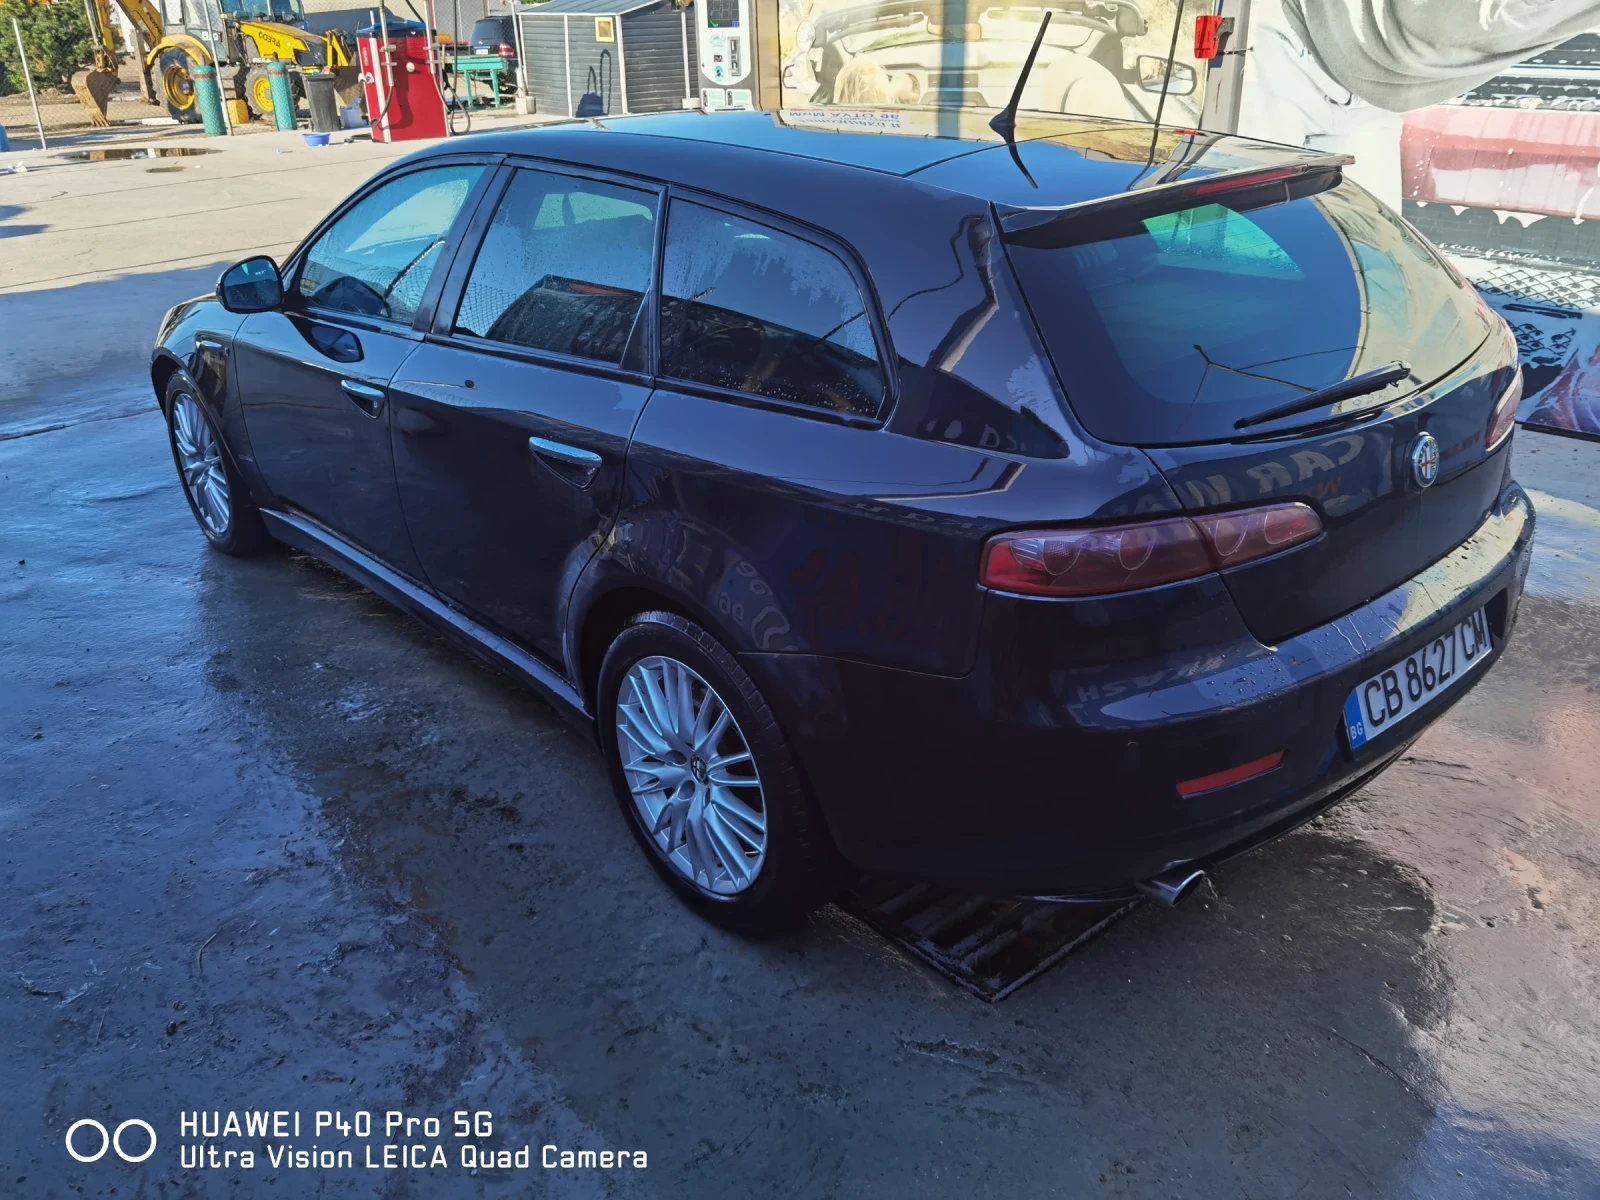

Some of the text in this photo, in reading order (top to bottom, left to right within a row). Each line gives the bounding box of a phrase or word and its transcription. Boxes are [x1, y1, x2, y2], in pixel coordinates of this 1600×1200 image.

[1364, 607, 1488, 728] CB 8627 CM
[1350, 722, 1364, 740] BG
